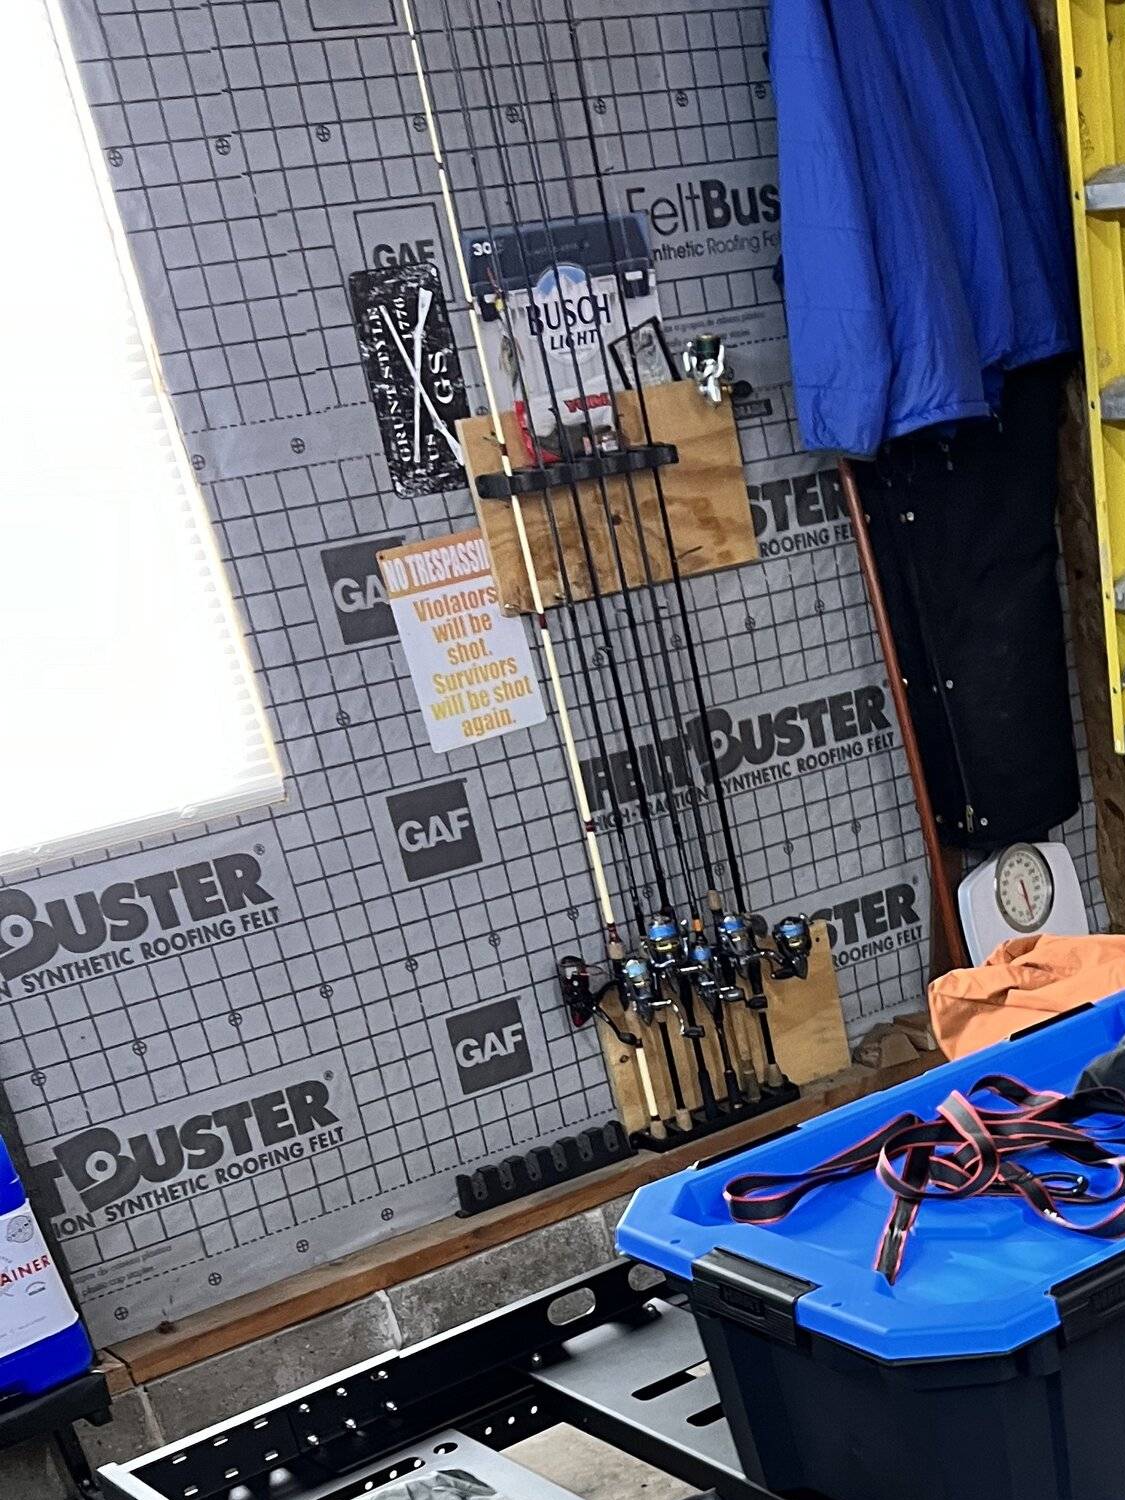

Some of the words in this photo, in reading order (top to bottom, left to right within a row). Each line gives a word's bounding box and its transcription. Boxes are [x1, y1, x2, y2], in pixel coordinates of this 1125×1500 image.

[372, 239, 436, 270] GAF
[471, 241, 492, 256] 30
[706, 234, 760, 254] Roofing
[525, 293, 612, 337] BUSCH
[550, 328, 599, 351] LIGHT
[427, 351, 454, 404] GS
[760, 527, 830, 558] ROOFING
[382, 557, 409, 592] NO
[412, 586, 498, 624] Violators
[432, 617, 466, 643] will
[470, 612, 493, 634] be
[447, 638, 493, 665] shot.
[432, 656, 518, 695] Survivors
[431, 697, 466, 721] will
[469, 689, 490, 711] be
[494, 675, 534, 702] shot
[461, 708, 517, 738] again.
[797, 743, 864, 774] ROOFING
[866, 731, 895, 752] FELT
[398, 807, 470, 853] GAF
[21, 947, 134, 994] SYNTHETIC
[140, 919, 236, 960] ROOFING
[240, 906, 281, 931] FELT
[897, 925, 923, 946] FELT
[455, 1022, 523, 1069] GAF
[106, 1173, 210, 1223] SYNTHETIC
[215, 1141, 305, 1183] ROOFING
[309, 1126, 345, 1151] FELT
